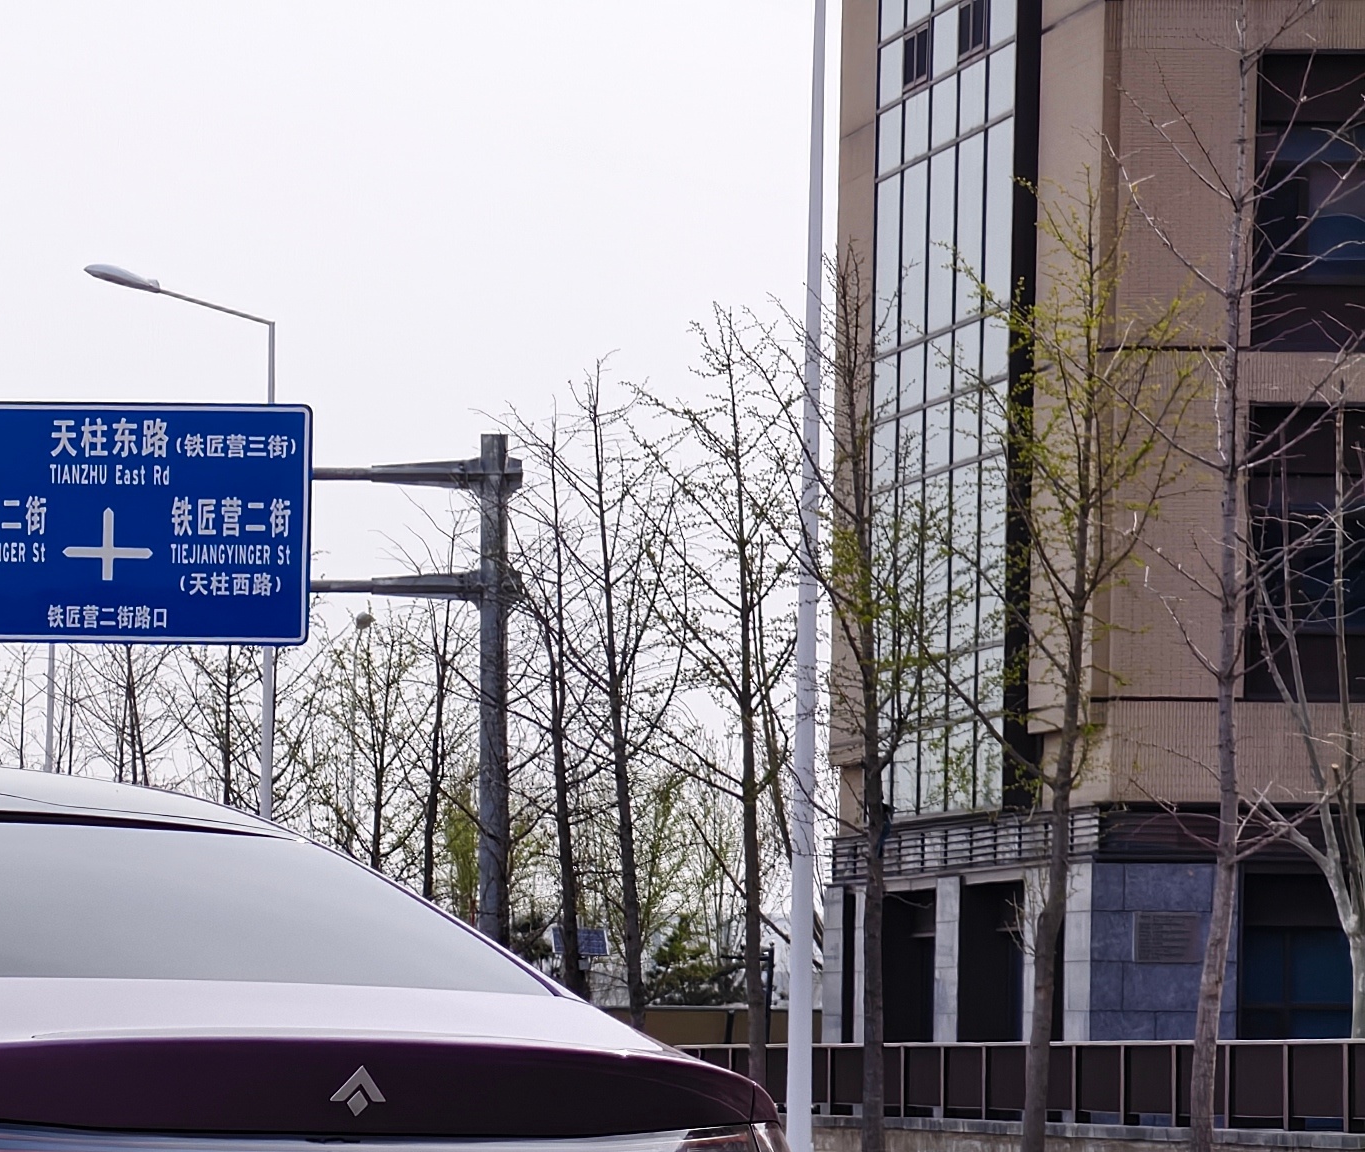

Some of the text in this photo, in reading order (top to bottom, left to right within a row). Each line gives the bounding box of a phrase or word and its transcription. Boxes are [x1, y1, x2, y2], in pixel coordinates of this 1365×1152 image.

[51, 418, 295, 458] 天柱东路 (铁匠营三街)
[50, 464, 169, 485] TIANZHU East Rd
[172, 497, 291, 537] 铁匠营二街
[33, 543, 45, 562] St
[171, 544, 290, 565] TIEJIANGYINGER St
[180, 572, 280, 596] (天柱西路)
[48, 605, 166, 629] 铁匠营二街路口
